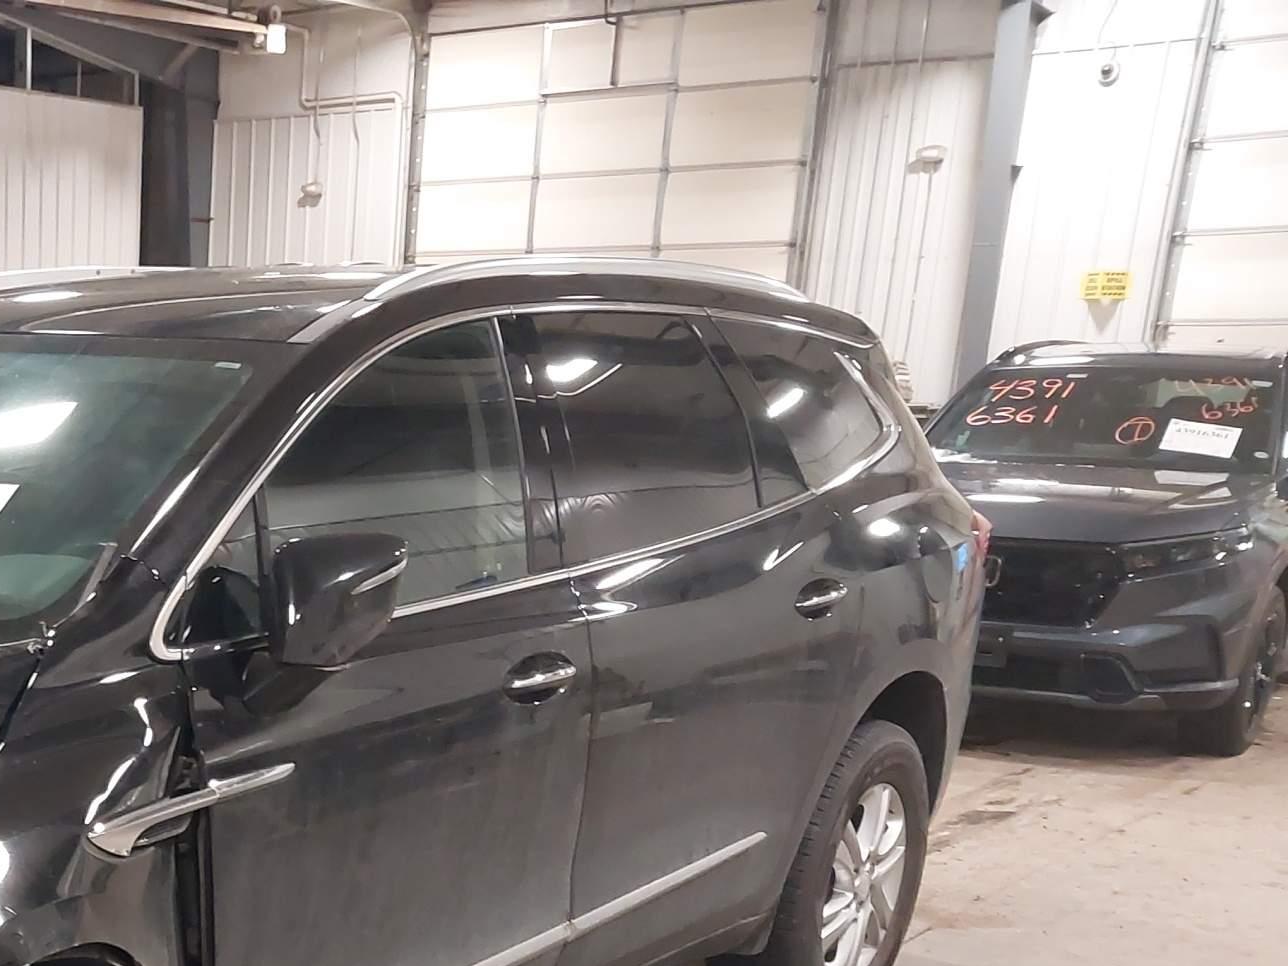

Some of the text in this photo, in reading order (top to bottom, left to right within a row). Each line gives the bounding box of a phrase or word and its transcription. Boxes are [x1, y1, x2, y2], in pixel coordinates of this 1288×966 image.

[989, 379, 1075, 402] 4391
[966, 404, 1059, 426] 6361
[1201, 396, 1259, 420] 6361
